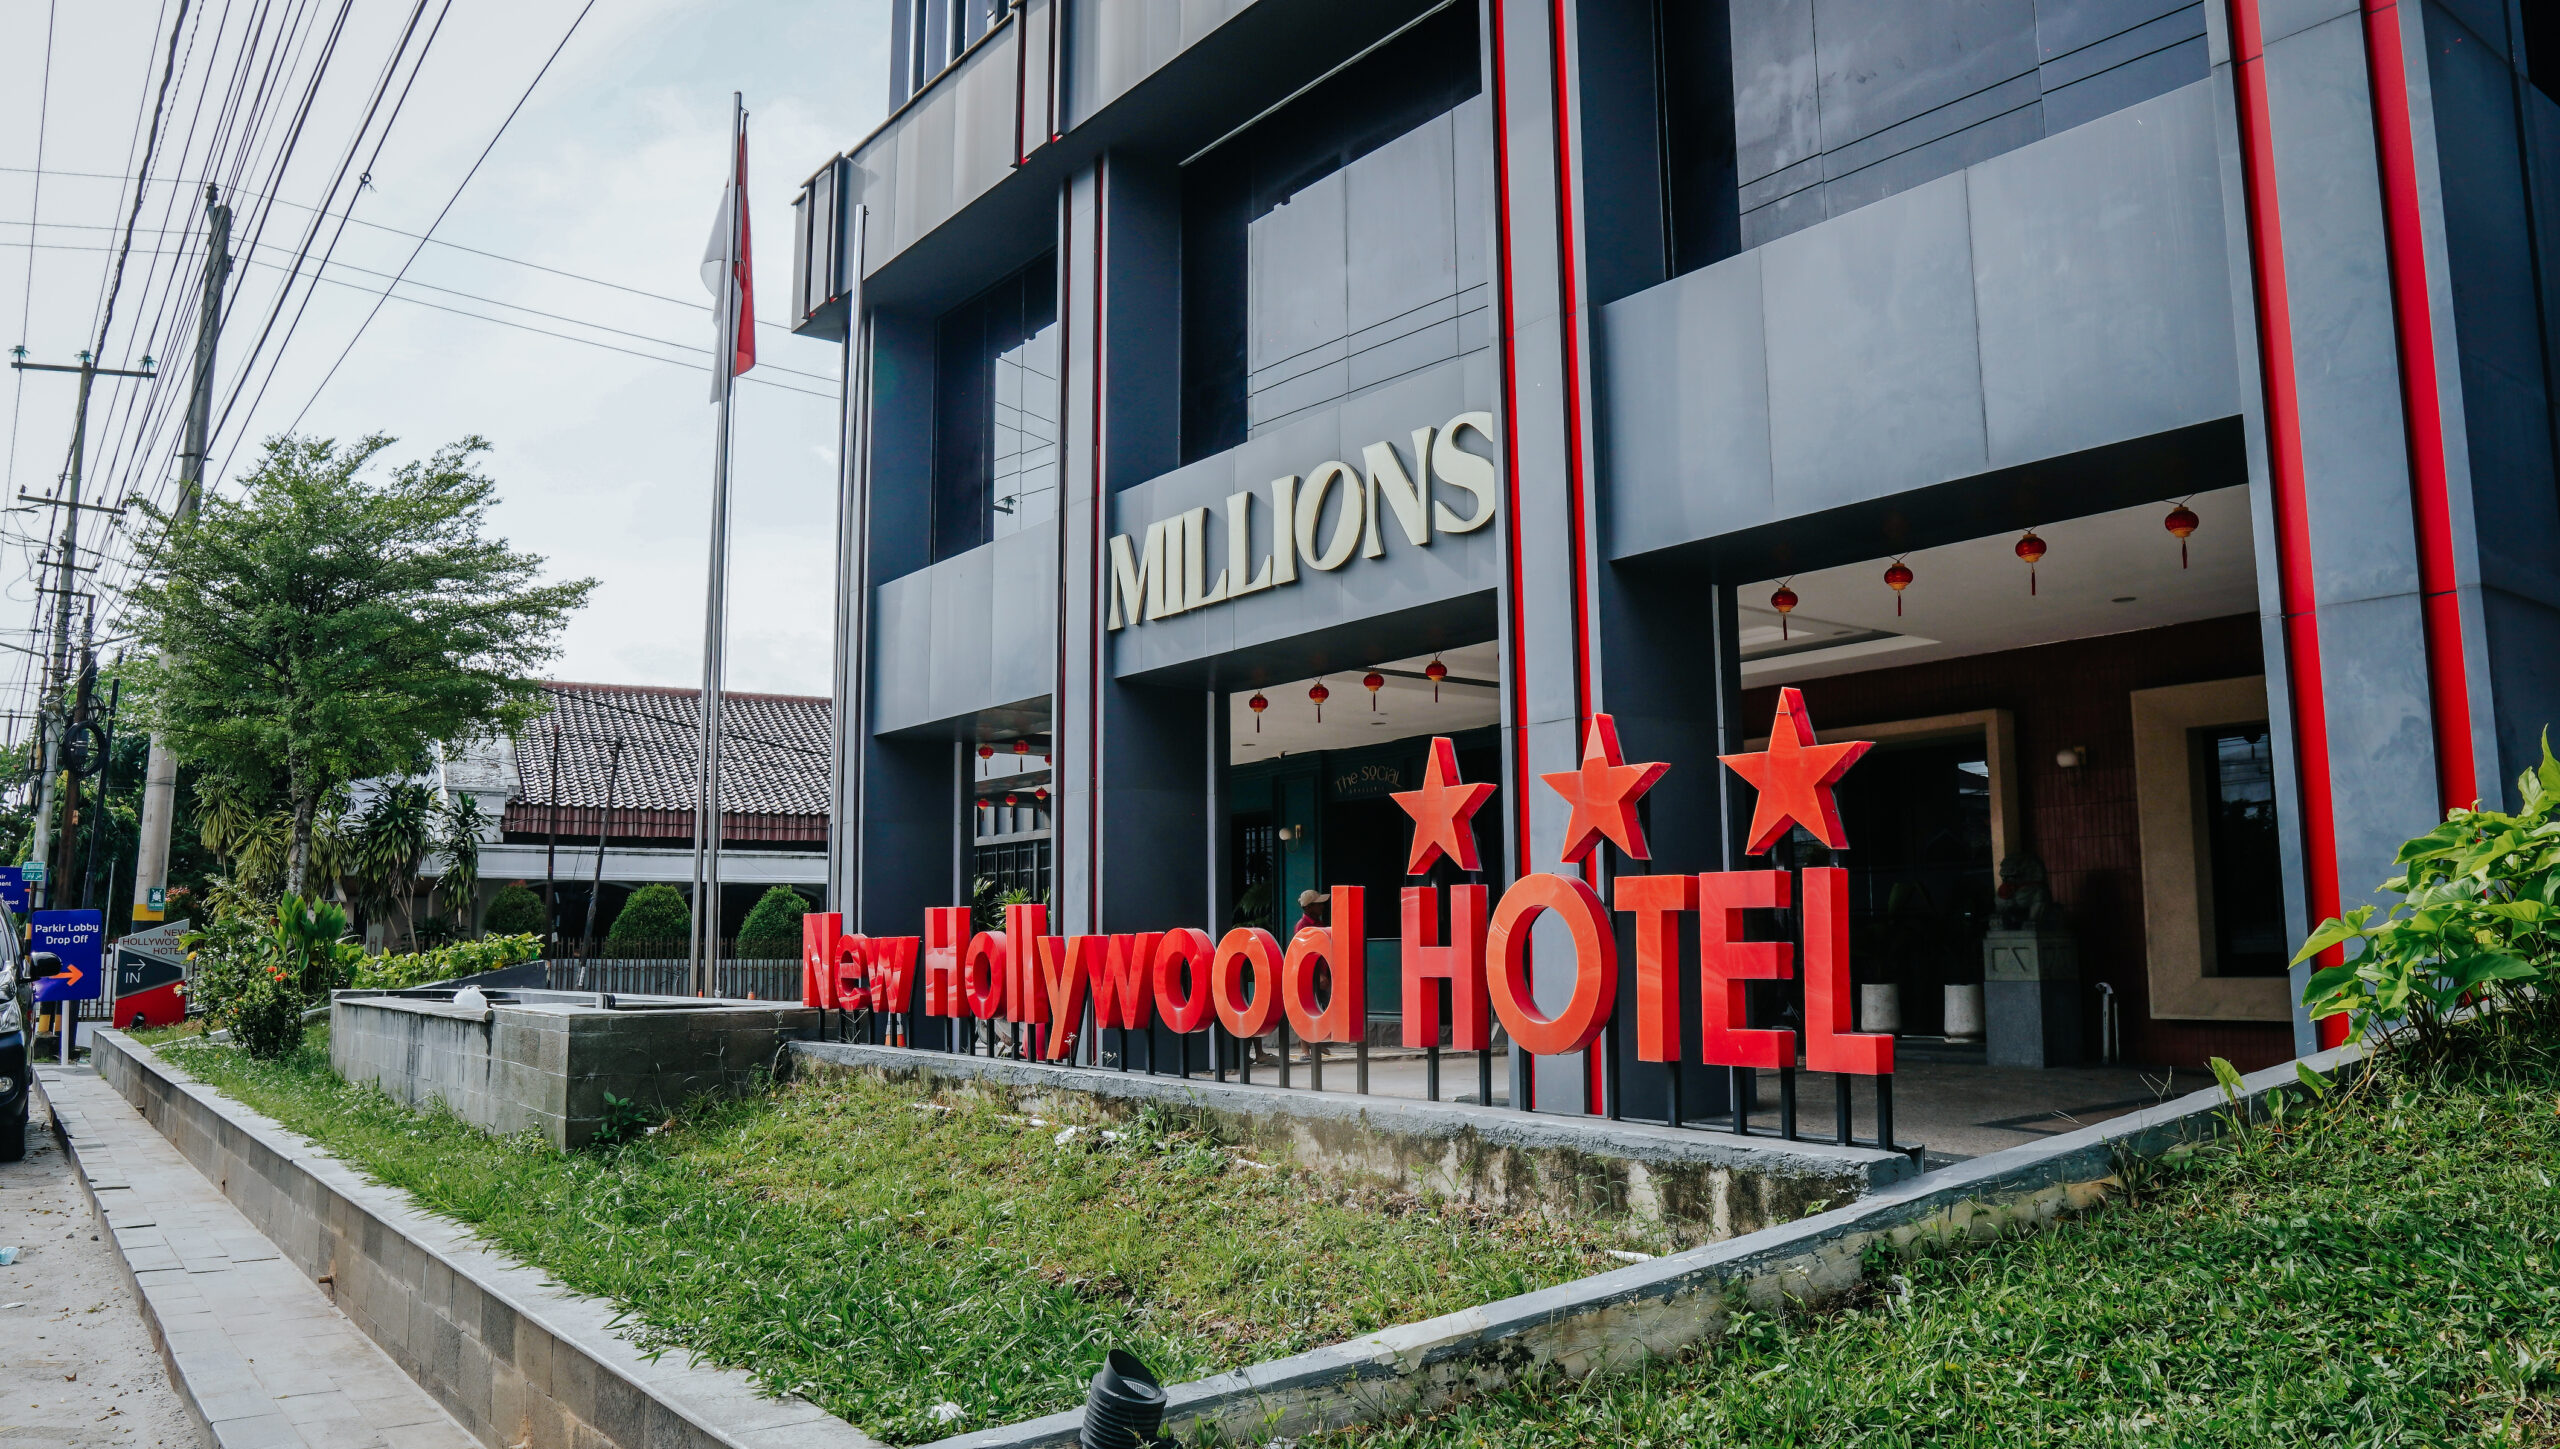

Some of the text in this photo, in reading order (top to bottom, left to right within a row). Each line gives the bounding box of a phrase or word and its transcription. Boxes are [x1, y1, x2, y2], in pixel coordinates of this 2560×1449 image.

[1107, 411, 1496, 631] MILLIONS
[35, 923, 99, 933] Parkir Lobby
[164, 929, 188, 937] NEW
[46, 934, 89, 946] Drop Off
[122, 937, 182, 946] HOLLYWOO
[153, 947, 186, 955] HOTEL
[803, 866, 1895, 1075] New Hollywood HOTEL
[125, 972, 141, 984] IN
